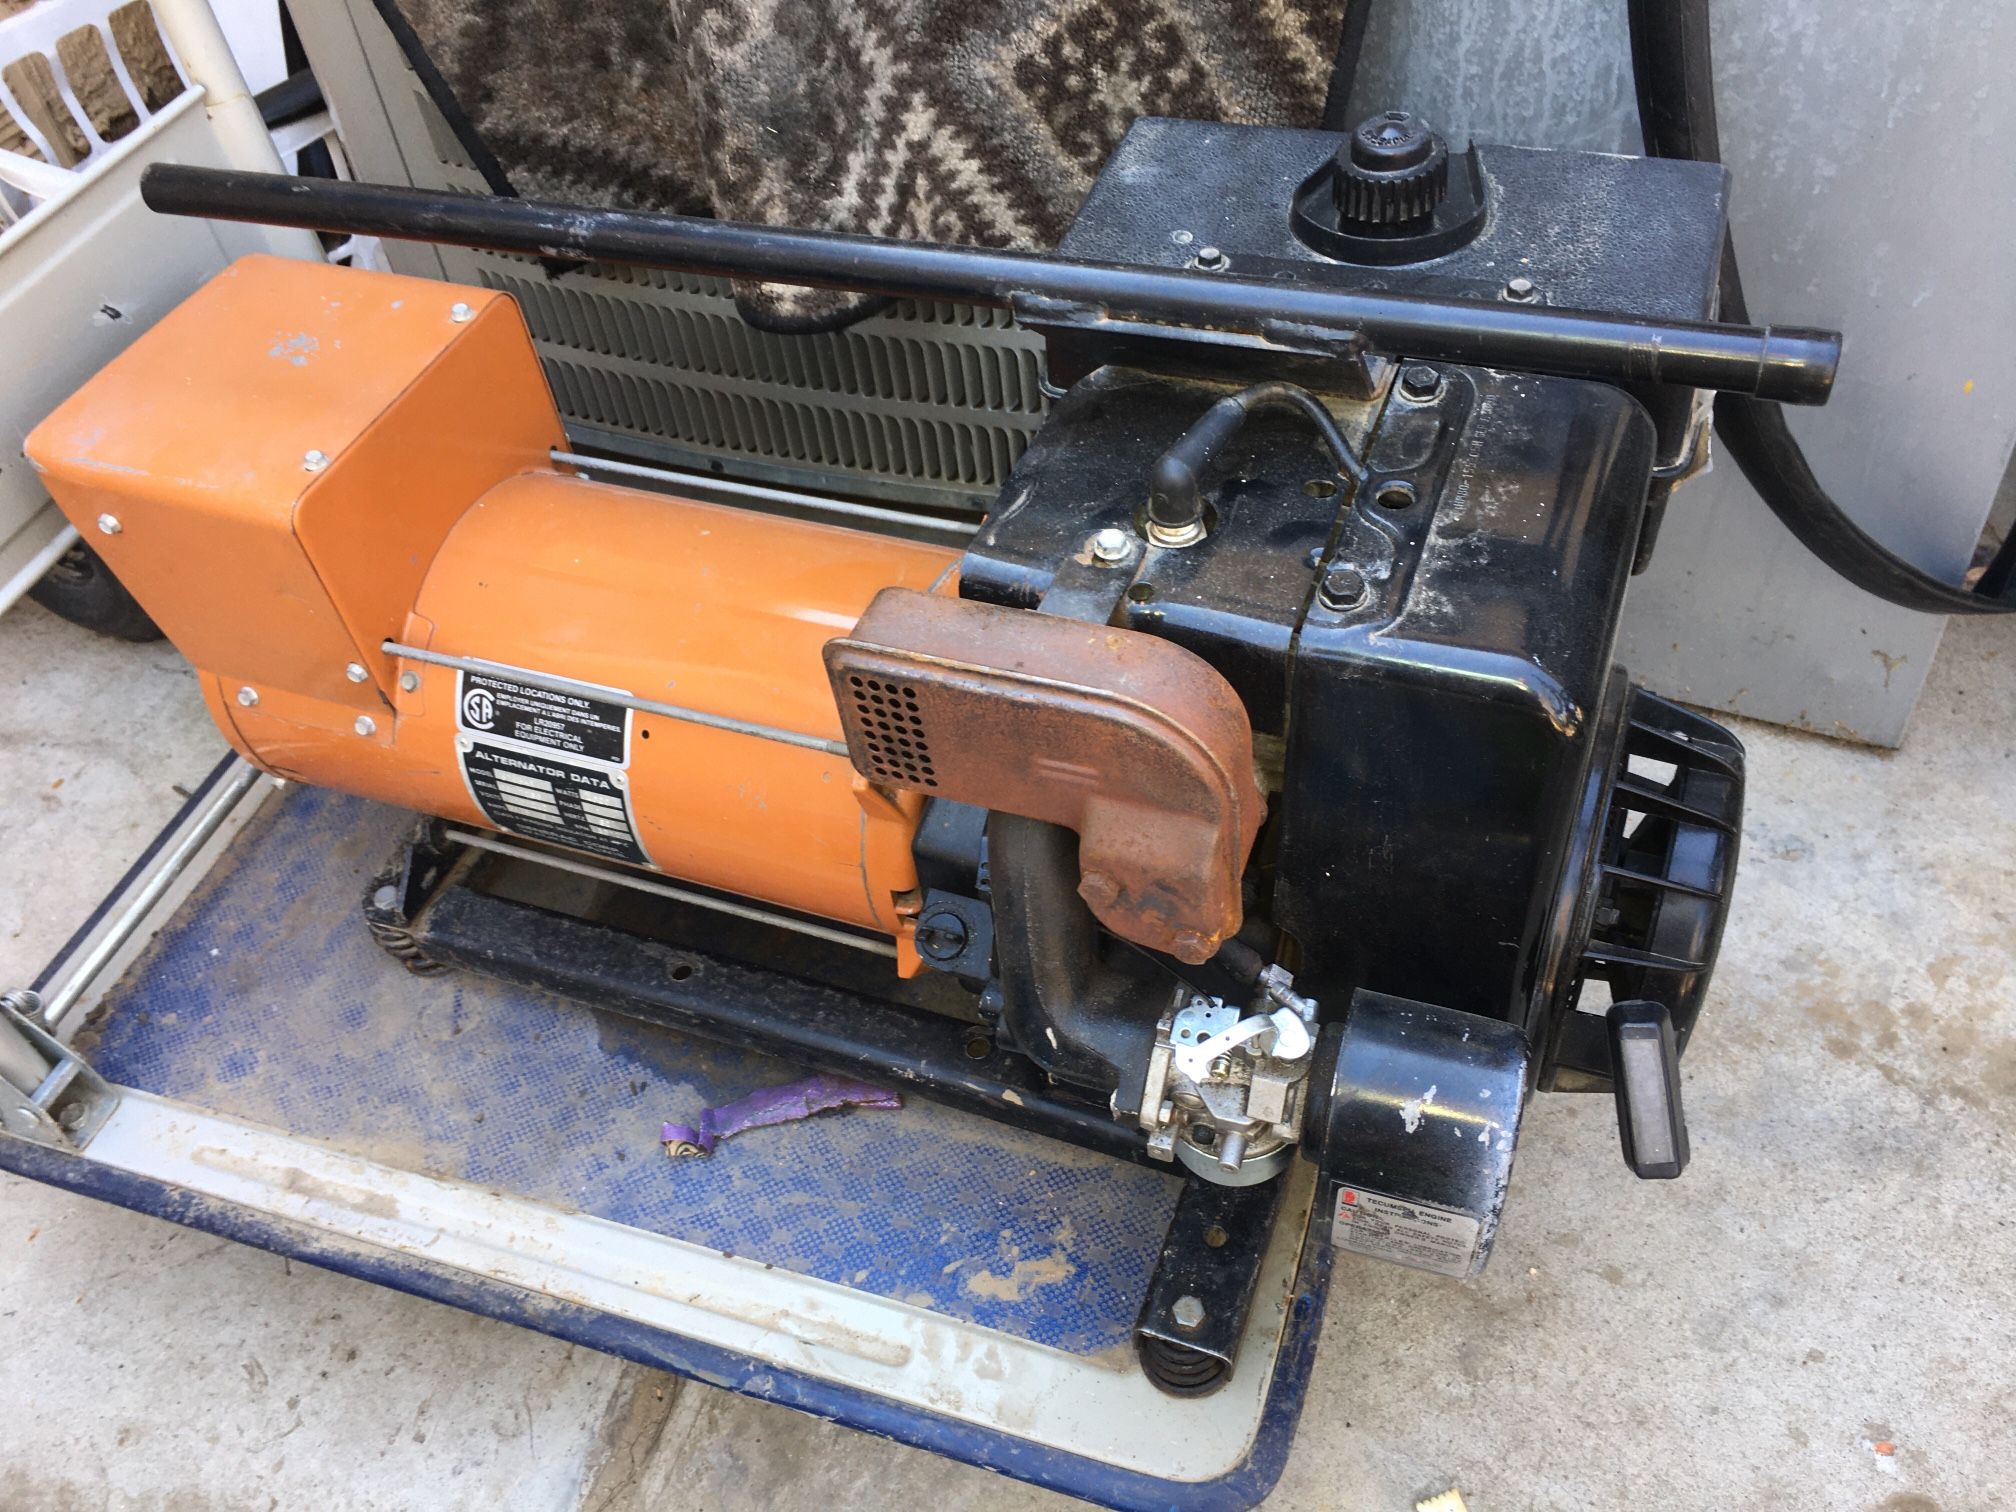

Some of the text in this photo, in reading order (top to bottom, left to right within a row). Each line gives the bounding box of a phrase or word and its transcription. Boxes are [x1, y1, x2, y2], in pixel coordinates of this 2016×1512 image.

[470, 675, 518, 693] PROTECTED
[519, 686, 565, 703] LOCATIONS
[496, 692, 529, 705] EMPLOYER
[530, 700, 570, 714] UNIQUEMENT
[571, 709, 592, 719] DANS
[496, 699, 540, 714] EMPLACEMENT
[567, 715, 579, 723] DES
[514, 729, 584, 752] EQUIPMENT ONLY
[516, 722, 582, 743] FOR ELECTRICAL
[475, 751, 566, 779] ALTERNATOR
[570, 773, 611, 790] DATA
[1418, 1210, 1452, 1223] ENGINE
